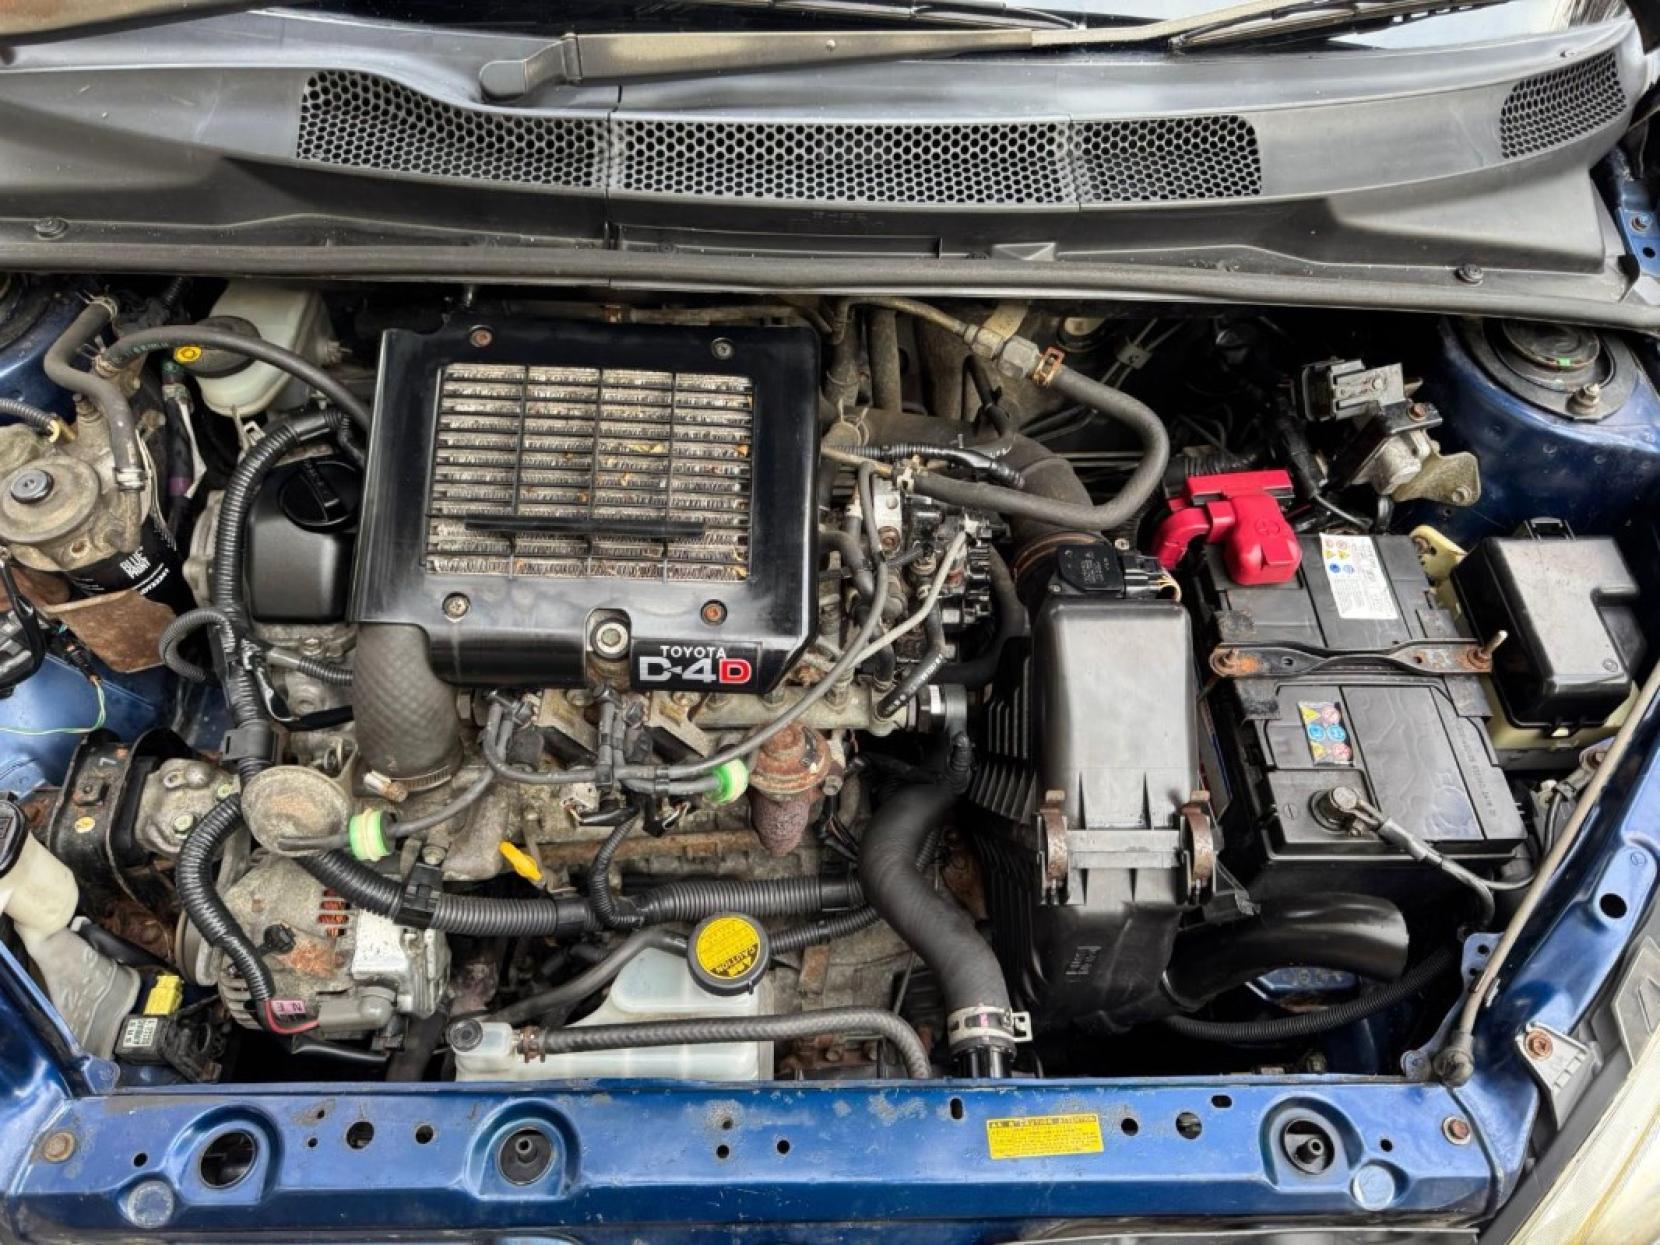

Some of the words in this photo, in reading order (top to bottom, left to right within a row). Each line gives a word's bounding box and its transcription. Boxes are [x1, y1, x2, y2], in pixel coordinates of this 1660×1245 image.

[660, 645, 727, 660] TOYOTA
[639, 656, 752, 684] D-4D
[716, 946, 756, 974] CAUTION
